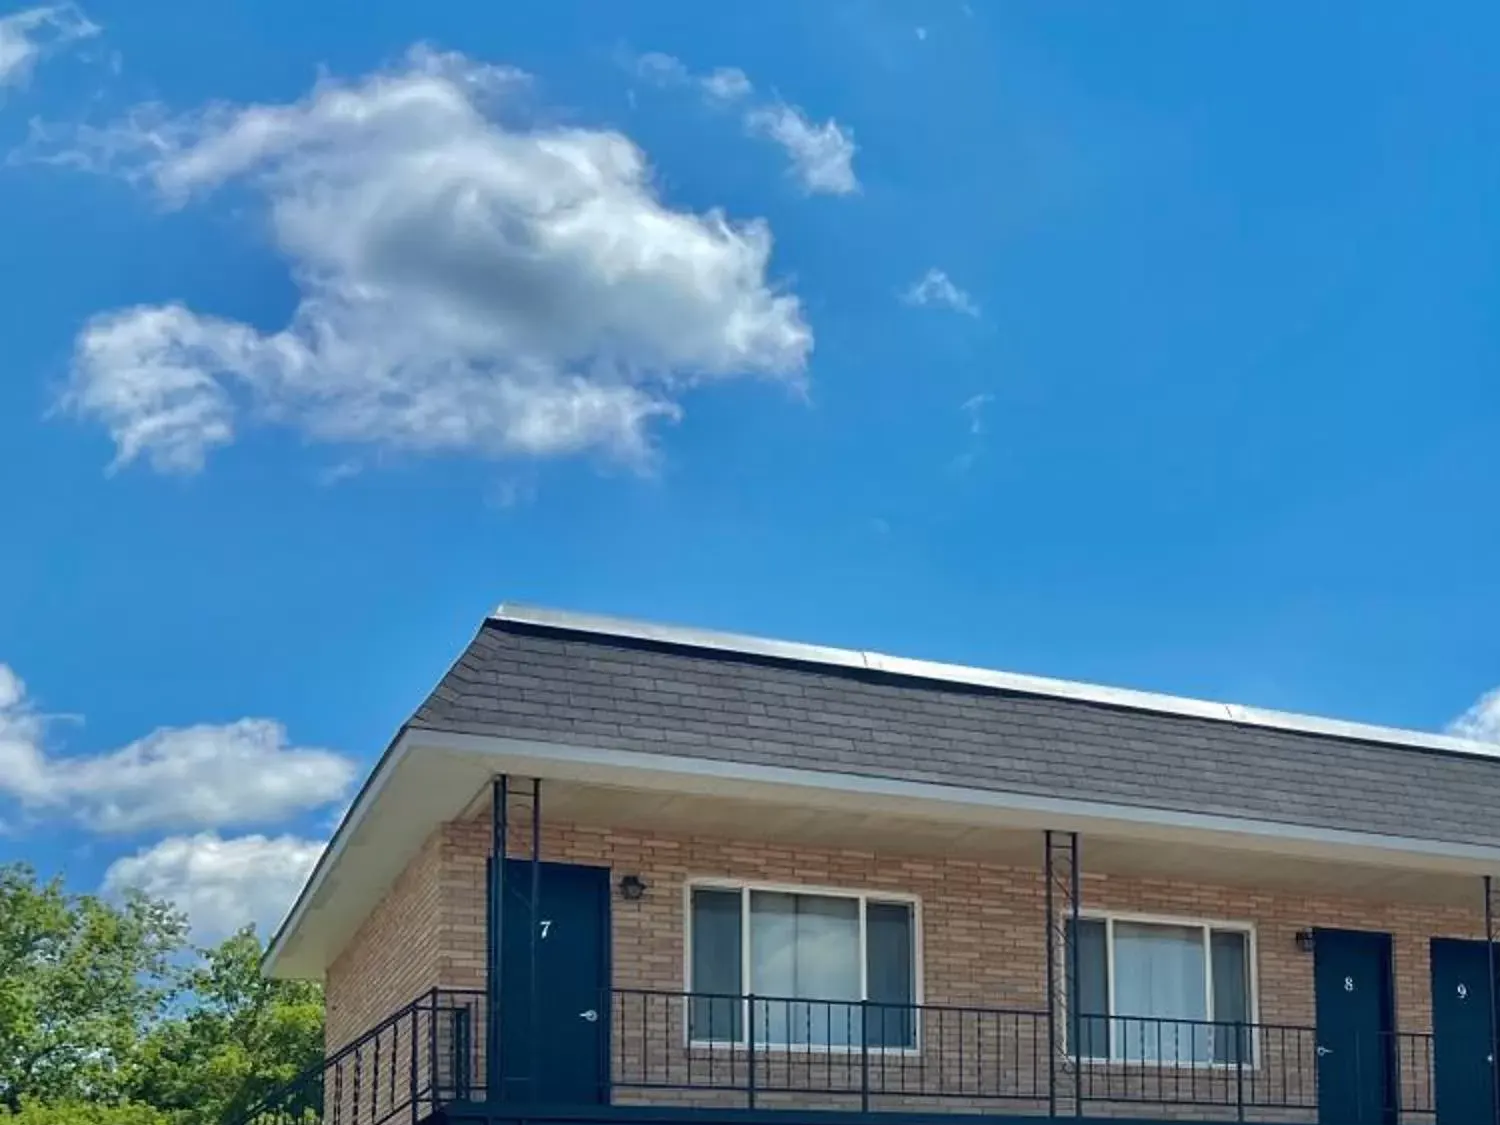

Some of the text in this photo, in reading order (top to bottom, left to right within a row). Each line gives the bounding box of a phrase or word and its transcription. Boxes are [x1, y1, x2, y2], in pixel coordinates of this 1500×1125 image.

[540, 920, 551, 939] 7
[1344, 976, 1354, 991] 8
[1456, 984, 1467, 999] 9
